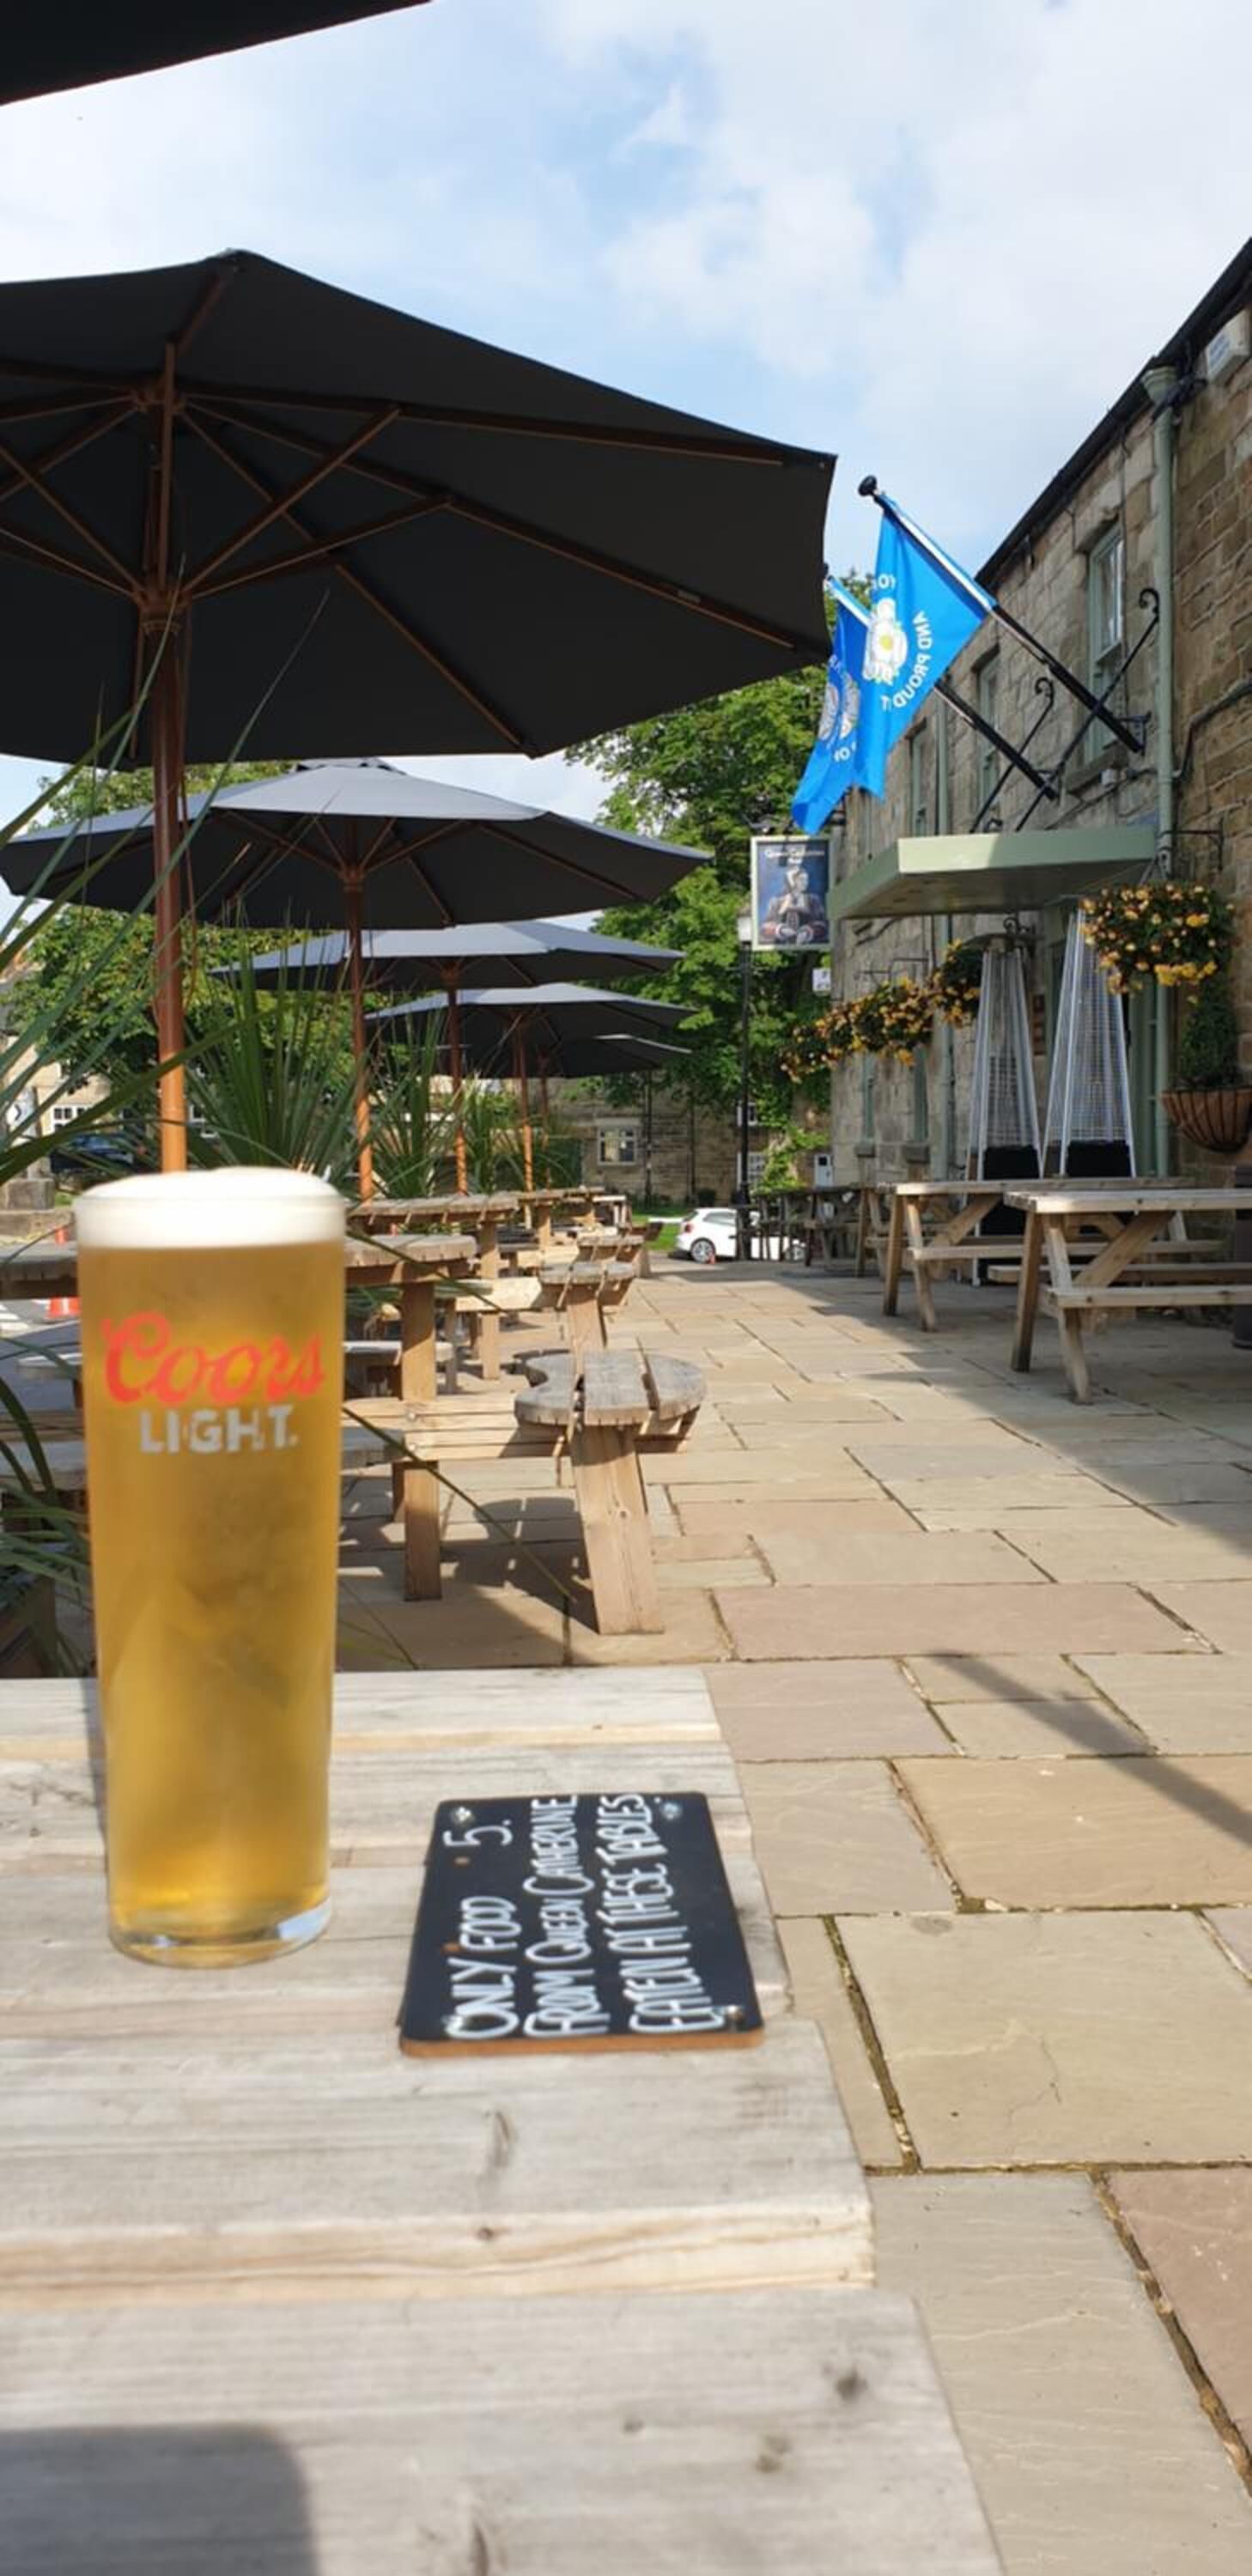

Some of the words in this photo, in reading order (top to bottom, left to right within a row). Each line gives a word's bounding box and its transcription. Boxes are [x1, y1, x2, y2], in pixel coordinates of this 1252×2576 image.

[100, 1310, 325, 1405] Coors
[522, 1795, 595, 1896] CATHERINE
[459, 1895, 521, 1952] FOOD
[597, 1862, 679, 1925] THESE
[604, 1926, 692, 1953] AT
[445, 1957, 520, 2038] ONLY
[522, 1968, 611, 2038] FROM
[619, 1956, 726, 2033] EATEN
